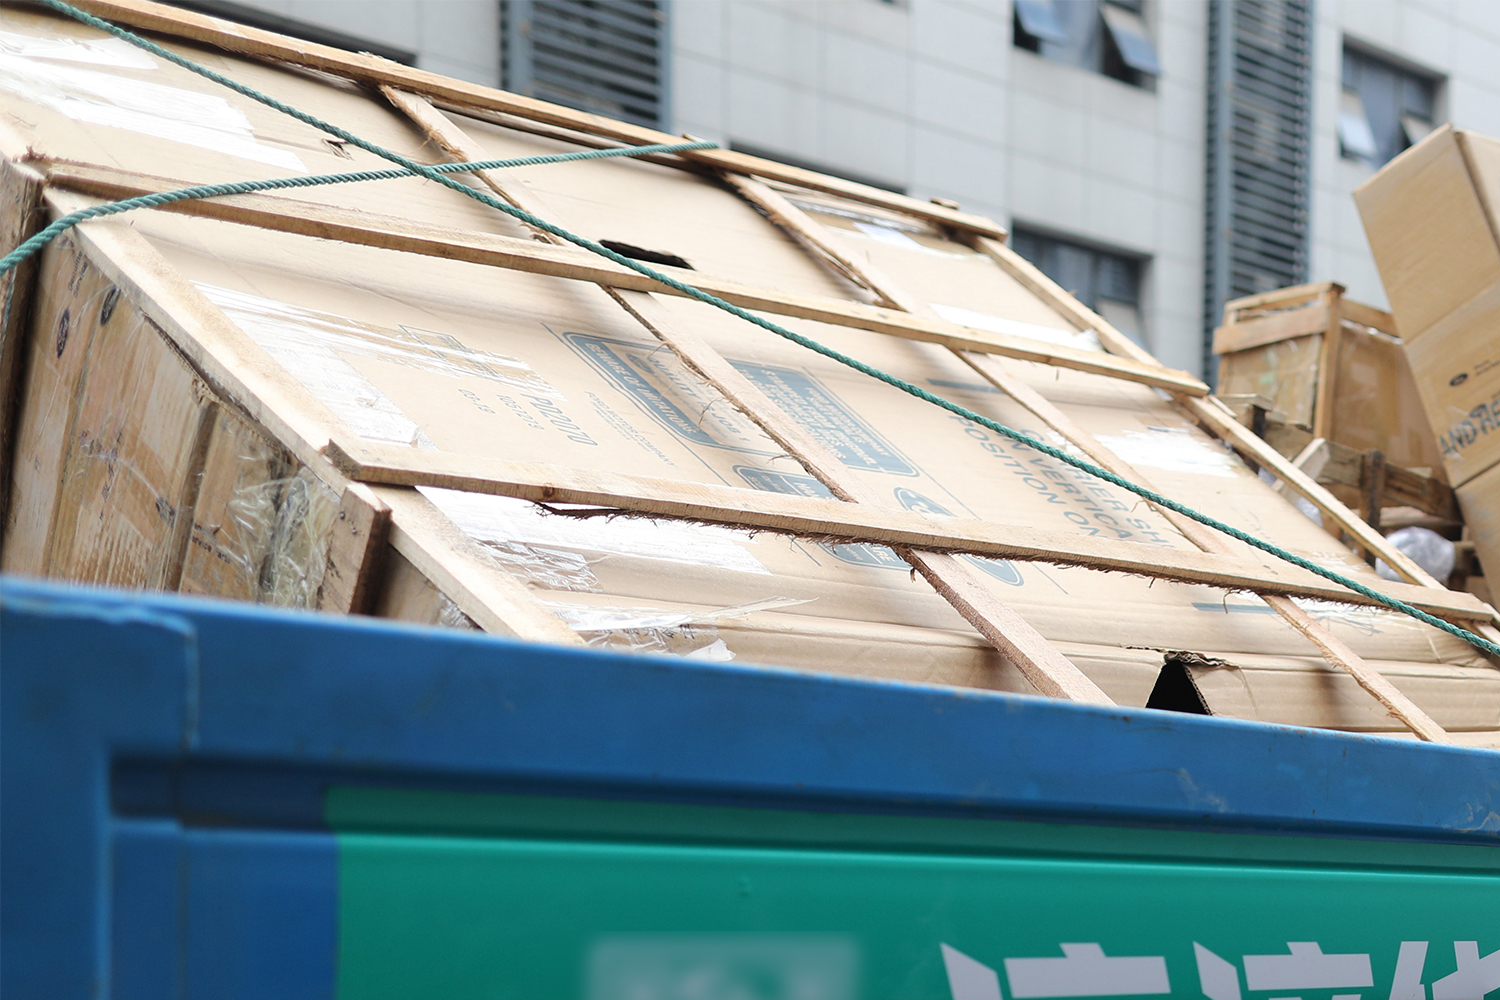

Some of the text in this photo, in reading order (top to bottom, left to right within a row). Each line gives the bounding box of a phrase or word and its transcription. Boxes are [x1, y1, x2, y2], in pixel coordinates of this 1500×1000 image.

[584, 343, 632, 377] BEWARE
[646, 356, 698, 398] QUALITY
[520, 392, 598, 446] PD2070
[949, 415, 1067, 505] POSITION
[1020, 429, 1129, 512] CRIER
